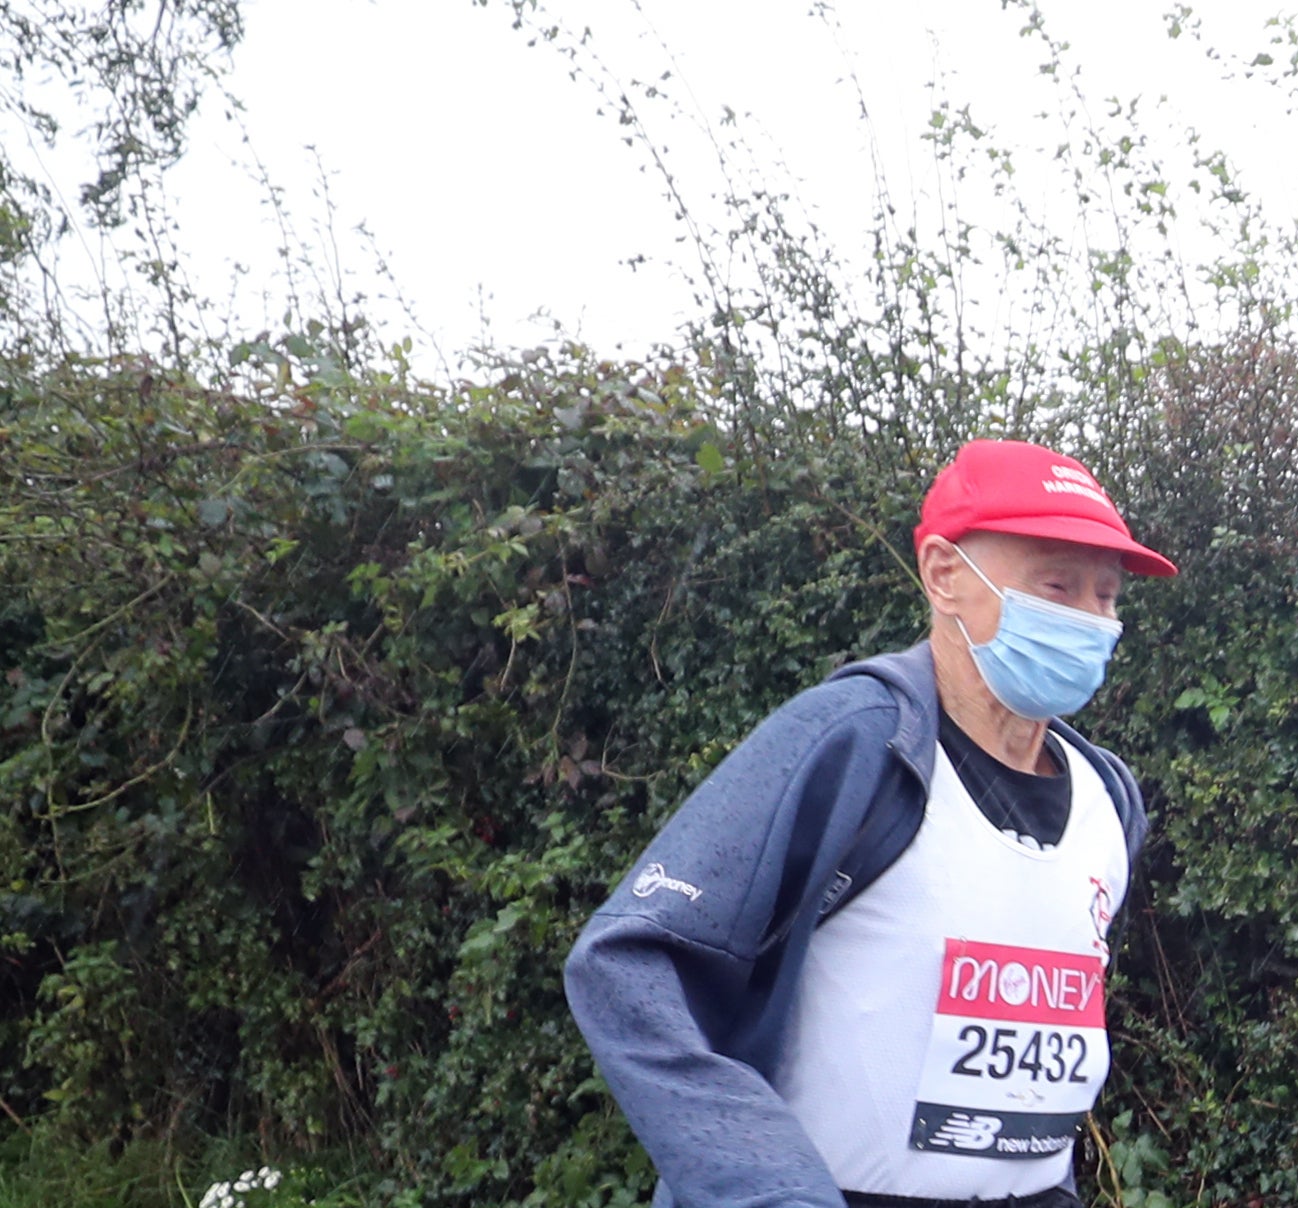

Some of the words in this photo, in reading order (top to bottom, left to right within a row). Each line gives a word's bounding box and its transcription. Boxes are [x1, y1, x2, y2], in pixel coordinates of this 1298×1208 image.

[949, 957, 1100, 1011] MONEY
[951, 1024, 1088, 1083] 25432
[997, 1137, 1030, 1153] new
